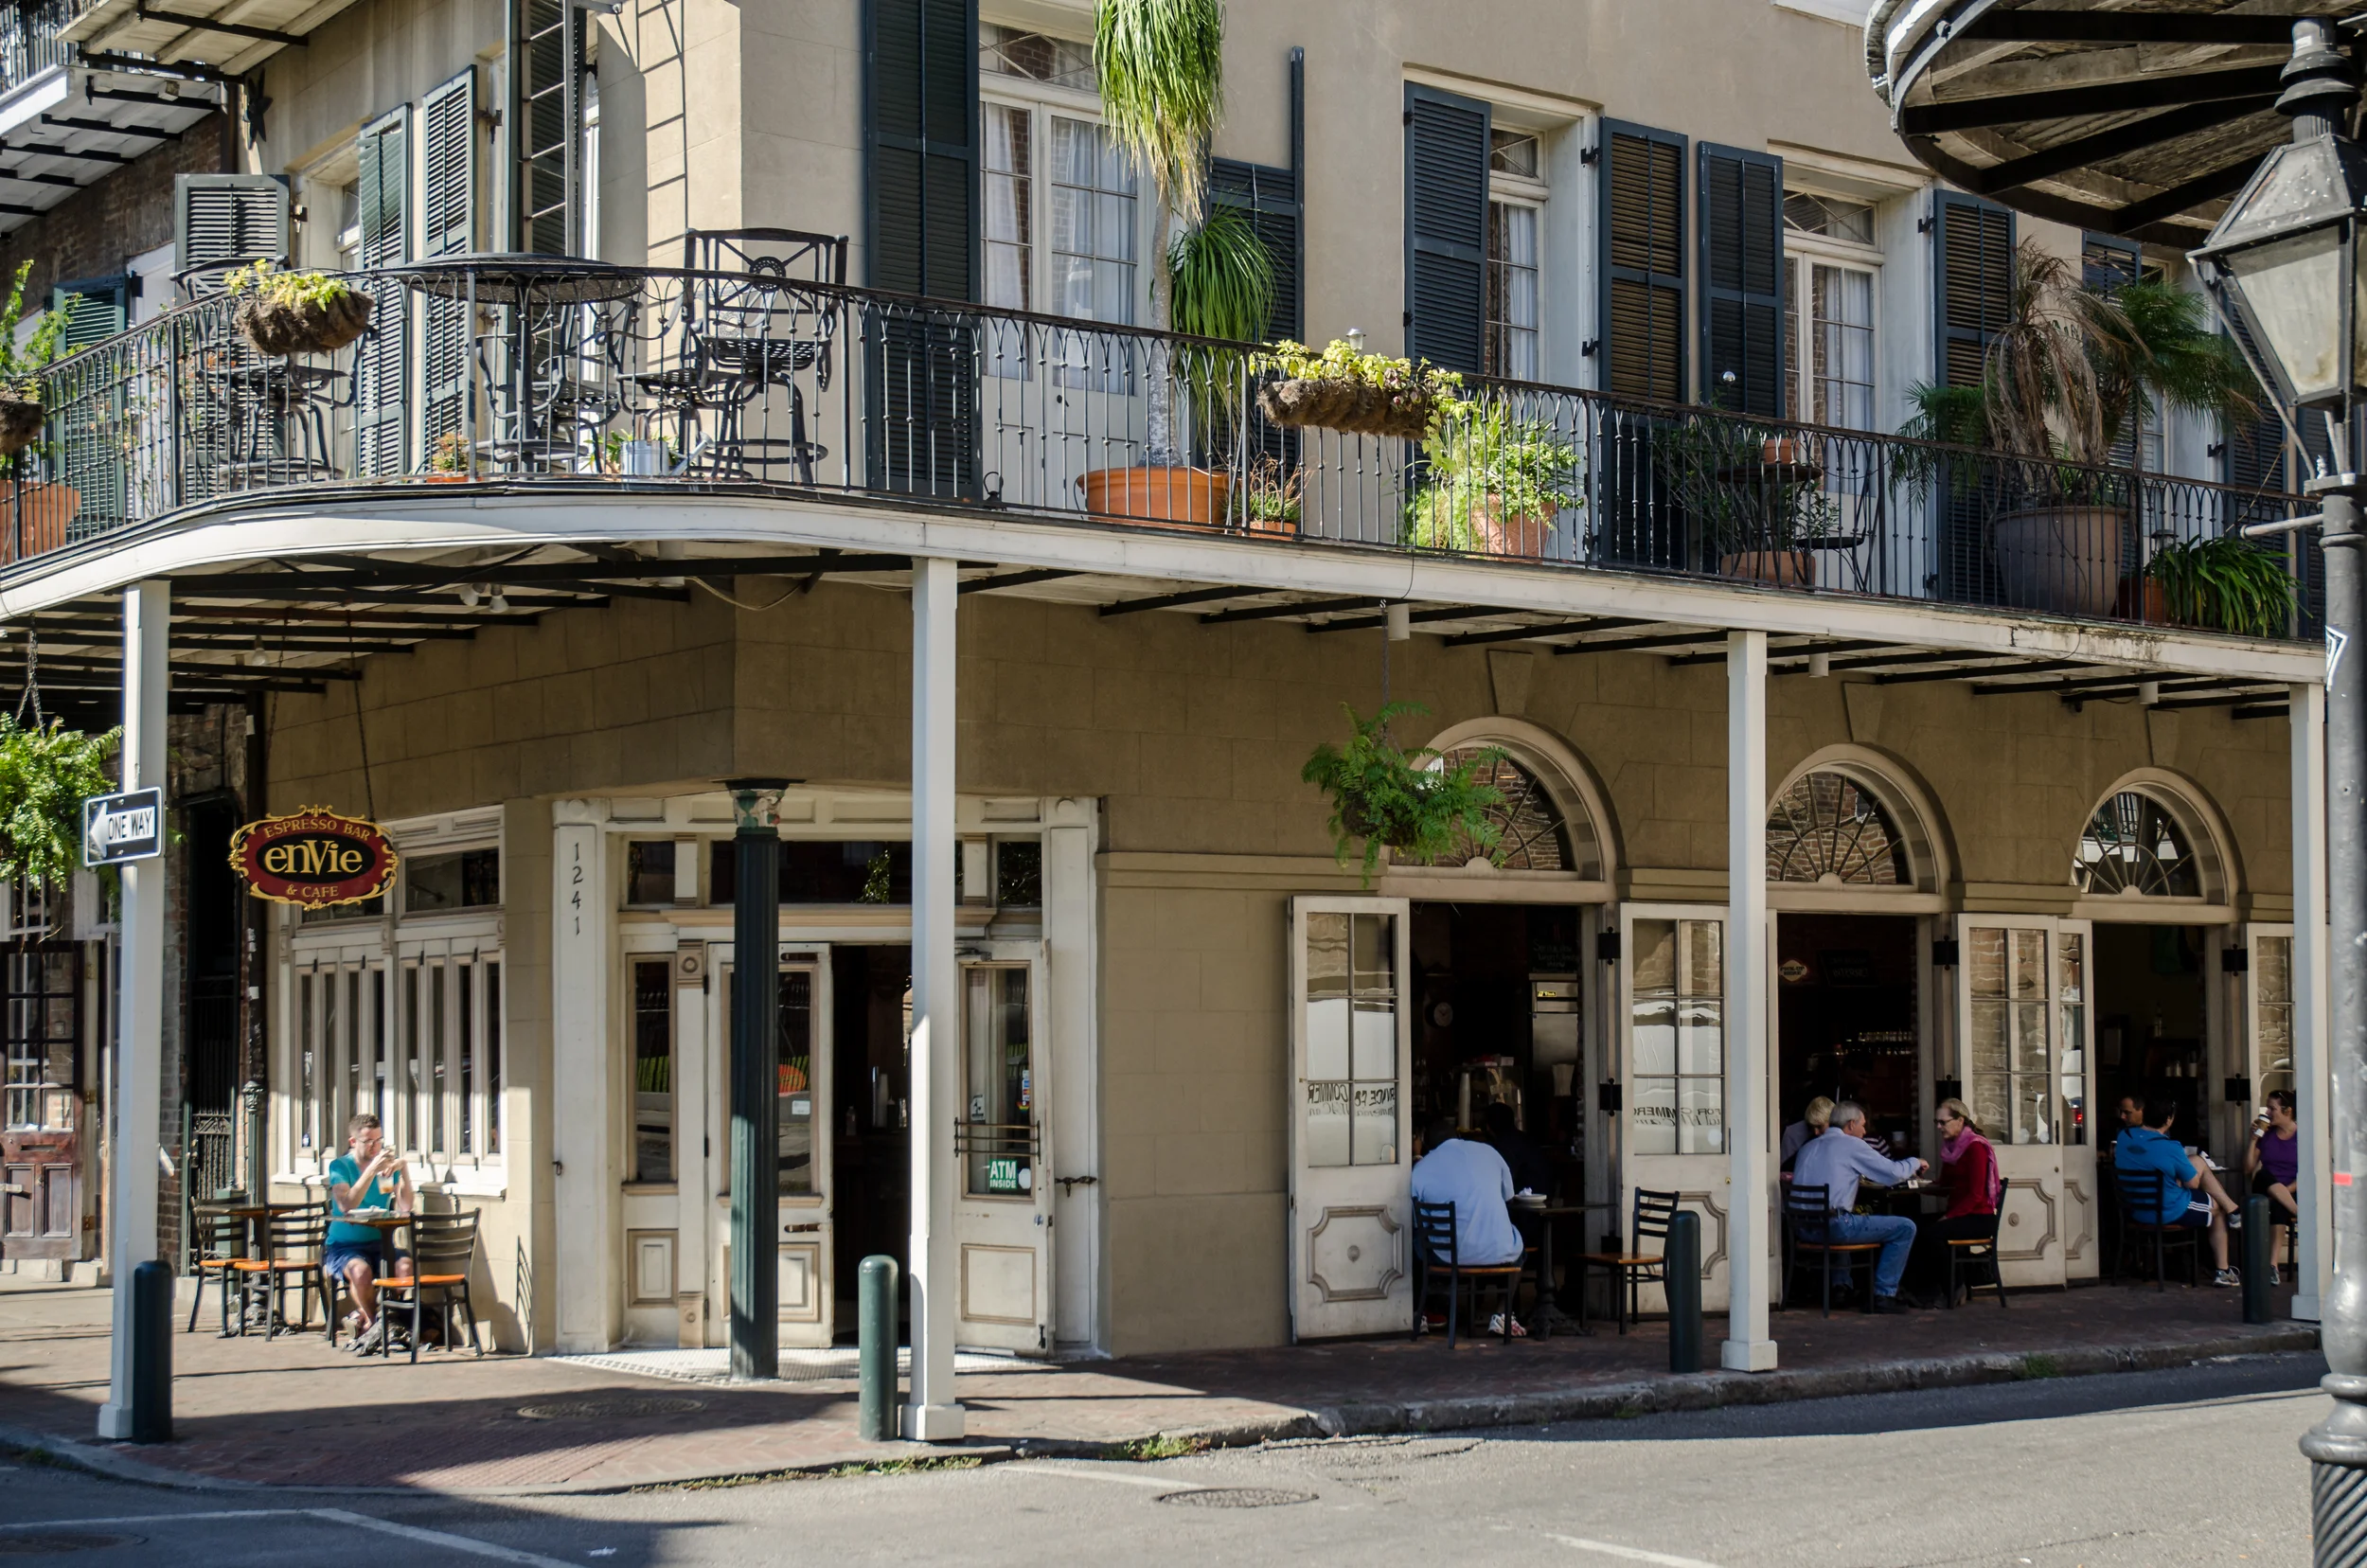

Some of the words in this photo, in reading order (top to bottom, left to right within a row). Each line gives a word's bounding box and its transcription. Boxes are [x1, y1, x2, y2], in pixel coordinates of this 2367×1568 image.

[108, 814, 127, 841] ONE
[131, 810, 152, 837] WAY
[263, 818, 337, 839] ESPRESSO
[343, 823, 371, 842] BAR
[264, 839, 363, 876] enVie
[287, 883, 298, 896] &
[302, 885, 340, 898] CAFE
[570, 841, 584, 936] 1241
[989, 1160, 1017, 1180] ATM
[989, 1179, 1017, 1189] INSIDE
